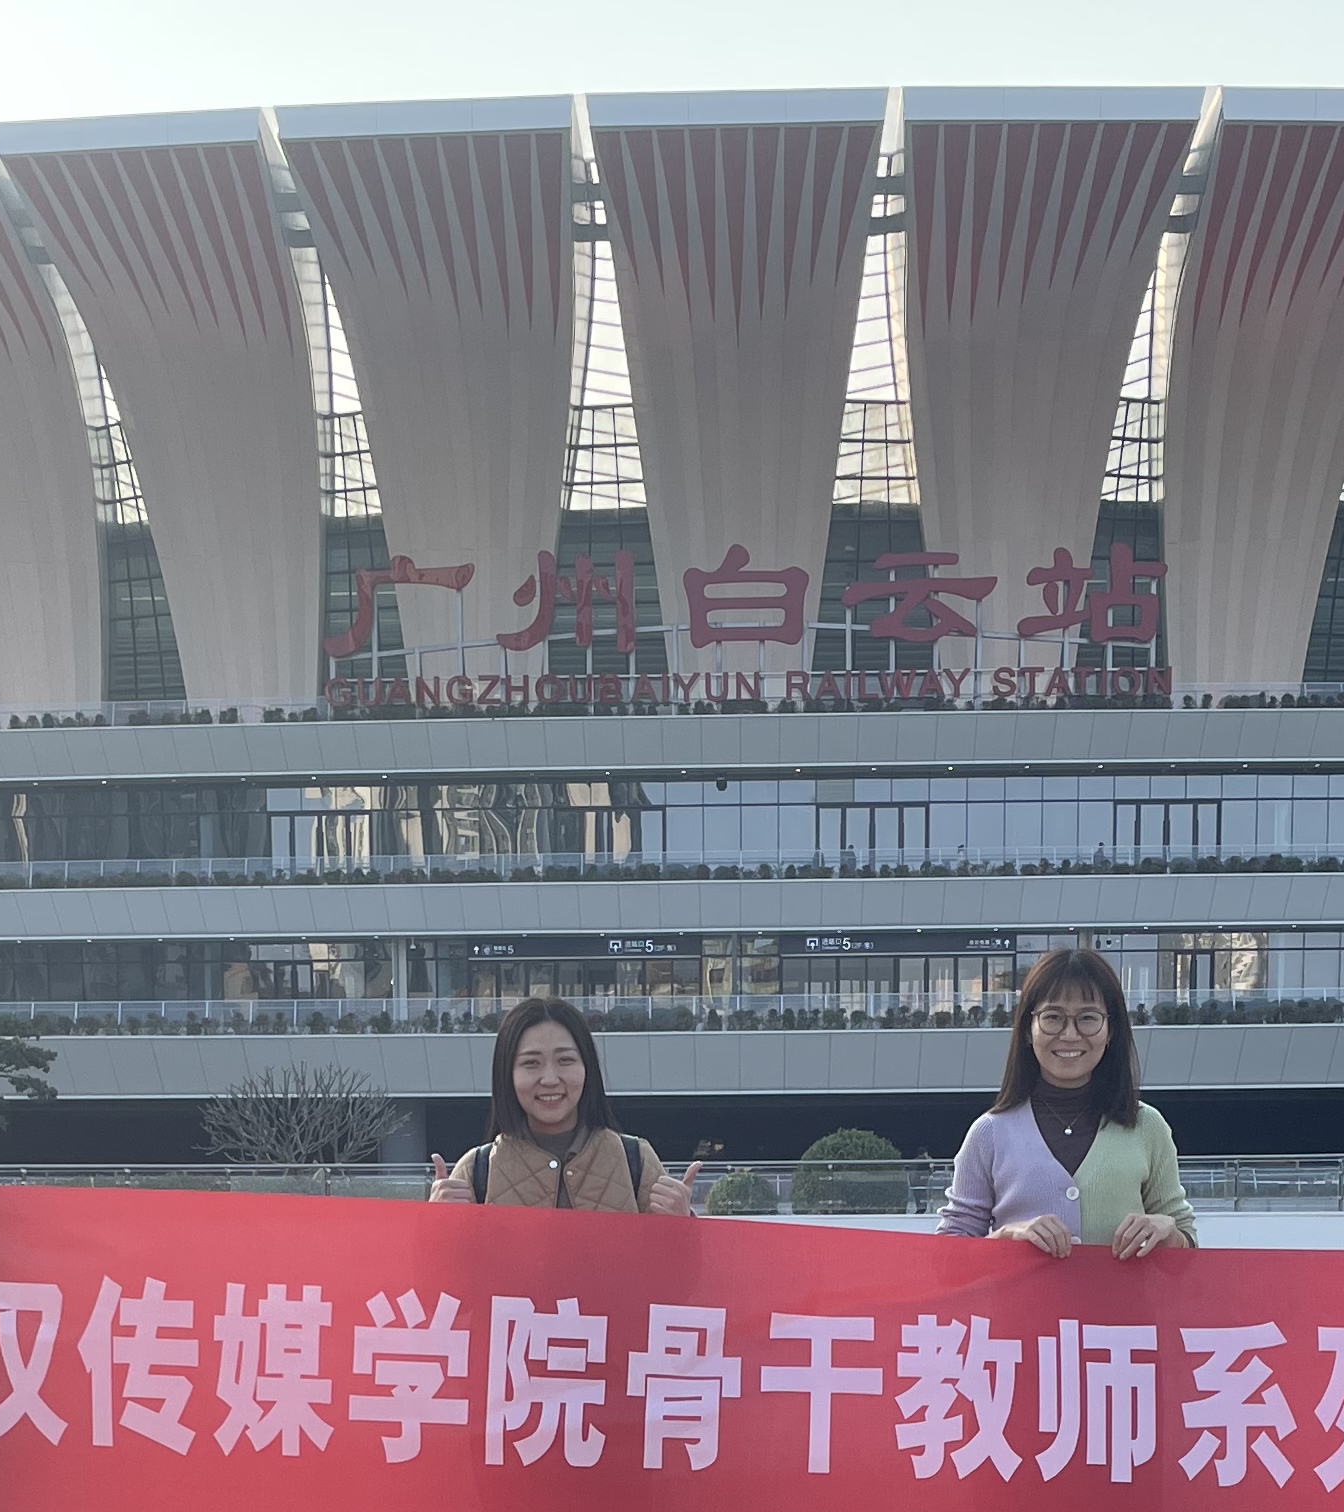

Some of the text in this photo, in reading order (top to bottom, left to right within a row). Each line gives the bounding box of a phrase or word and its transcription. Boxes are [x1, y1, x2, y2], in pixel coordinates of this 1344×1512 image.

[322, 543, 1168, 658] 广州白云站
[785, 667, 972, 701] RAILWAY
[991, 665, 1173, 698] STATION
[645, 939, 654, 953] 5
[842, 937, 851, 951] 5
